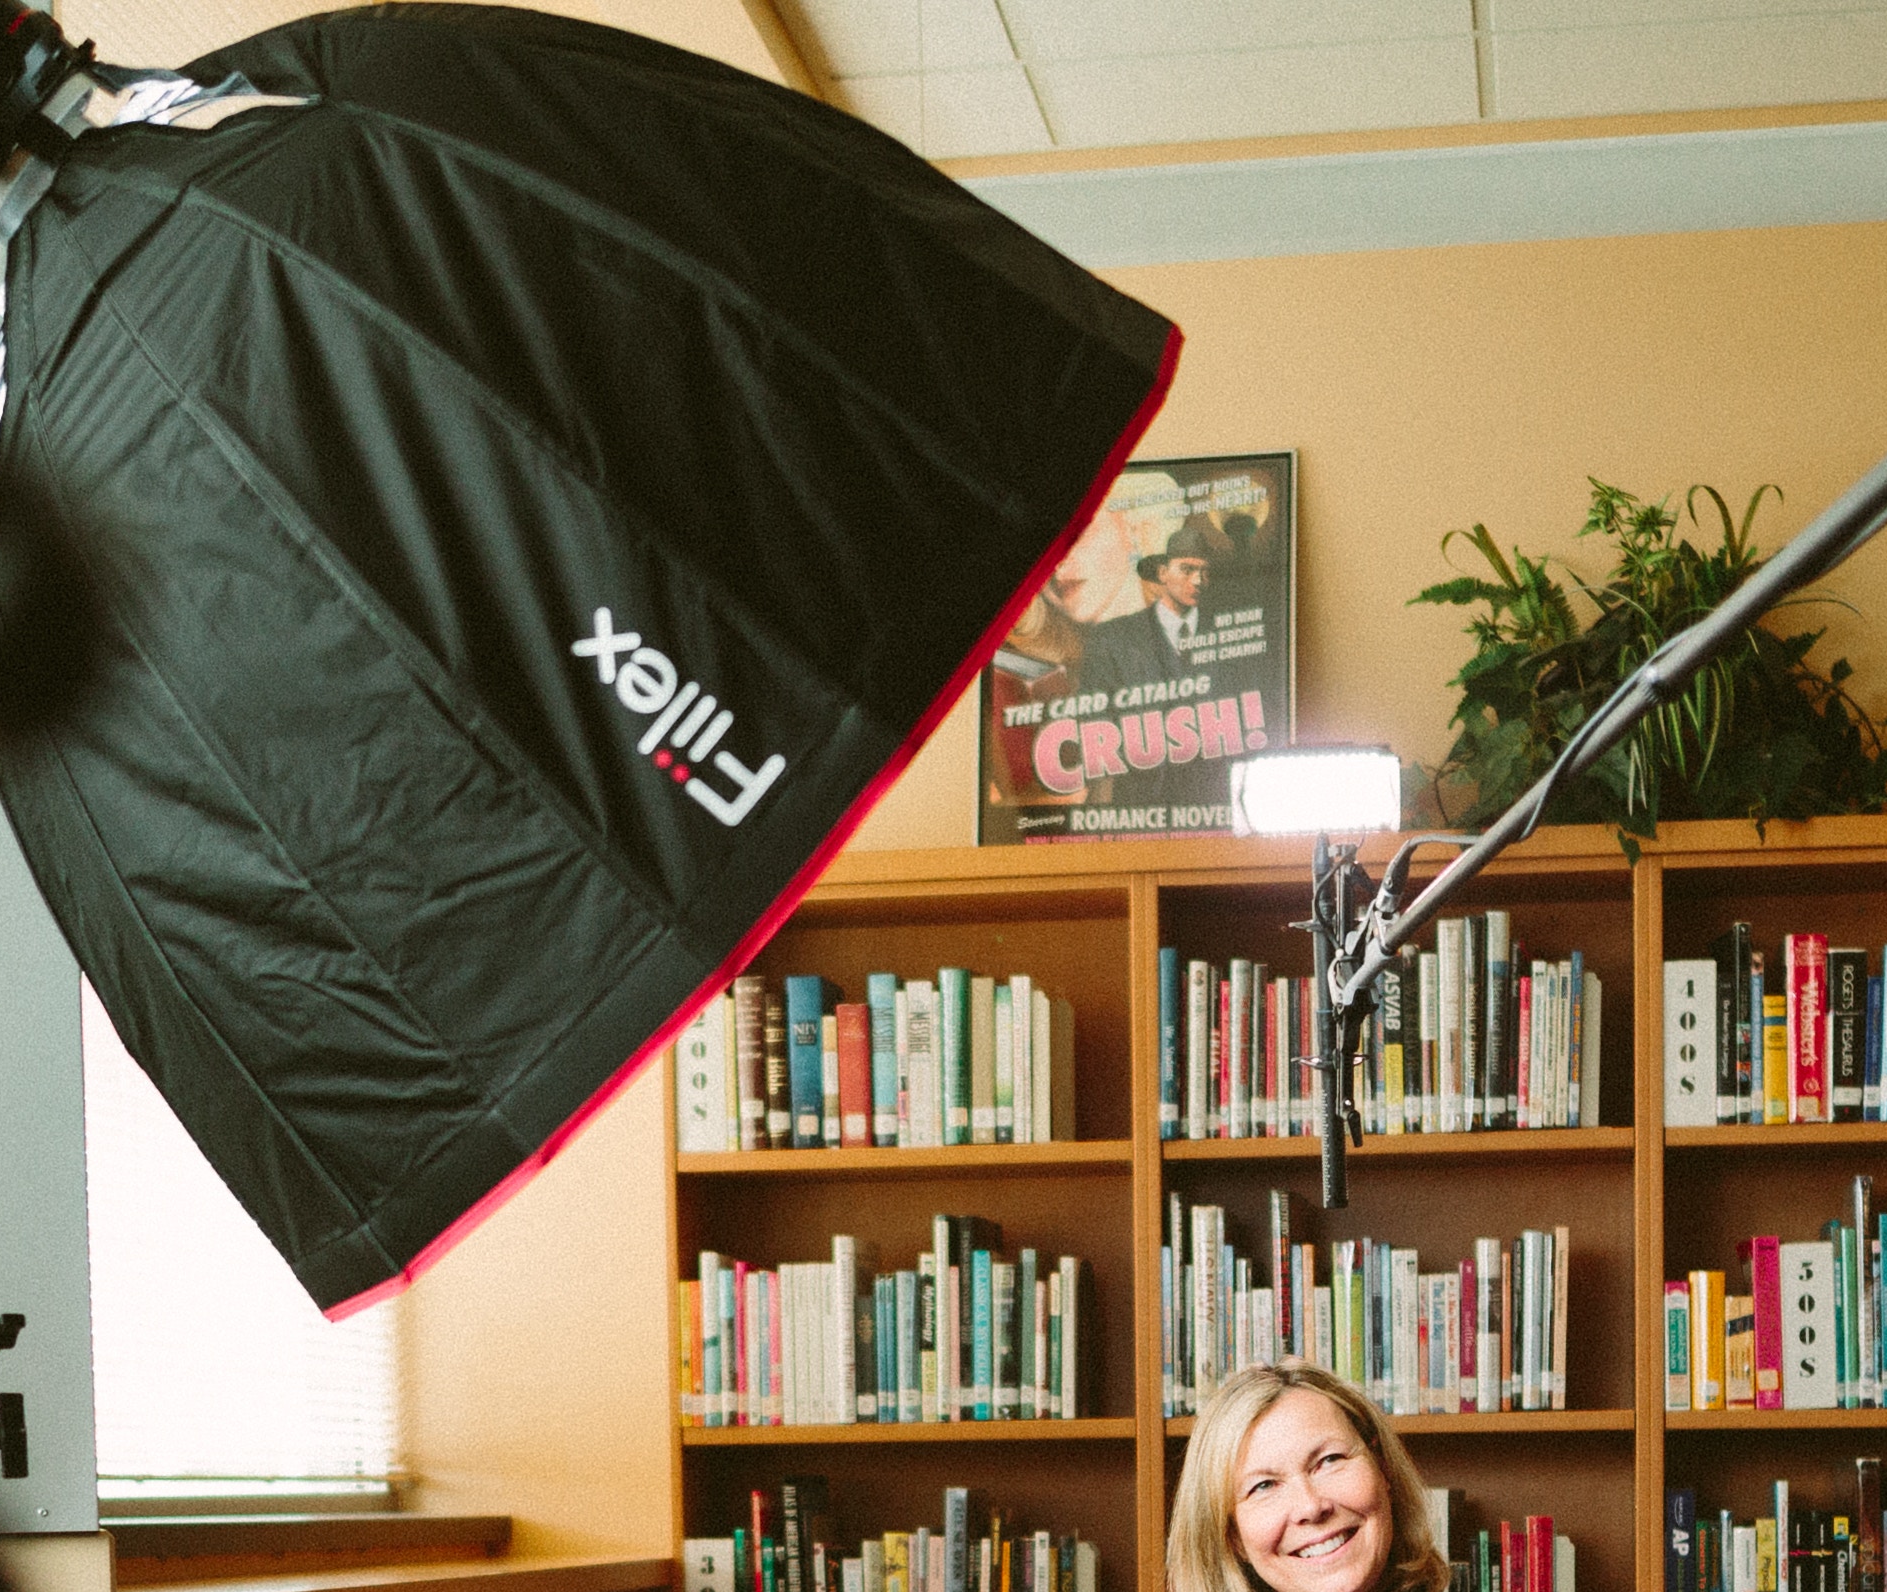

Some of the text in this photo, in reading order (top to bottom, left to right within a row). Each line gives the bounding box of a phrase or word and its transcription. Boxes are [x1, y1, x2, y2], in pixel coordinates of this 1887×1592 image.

[1178, 626, 1264, 651] COULD ESCAPE
[1192, 650, 1217, 666] HER
[571, 606, 787, 827] Fiilex
[1003, 675, 1211, 728] THE CARD CATALOG
[1032, 690, 1269, 795] CRUSH!
[1070, 806, 1168, 832] ROMANCE
[1384, 970, 1402, 1032] ASVAB
[1842, 1017, 1855, 1077] THESAURUS
[920, 1285, 934, 1344] Mythology
[1431, 1281, 1445, 1341] The Lost Boy
[1672, 1528, 1691, 1558] AP
